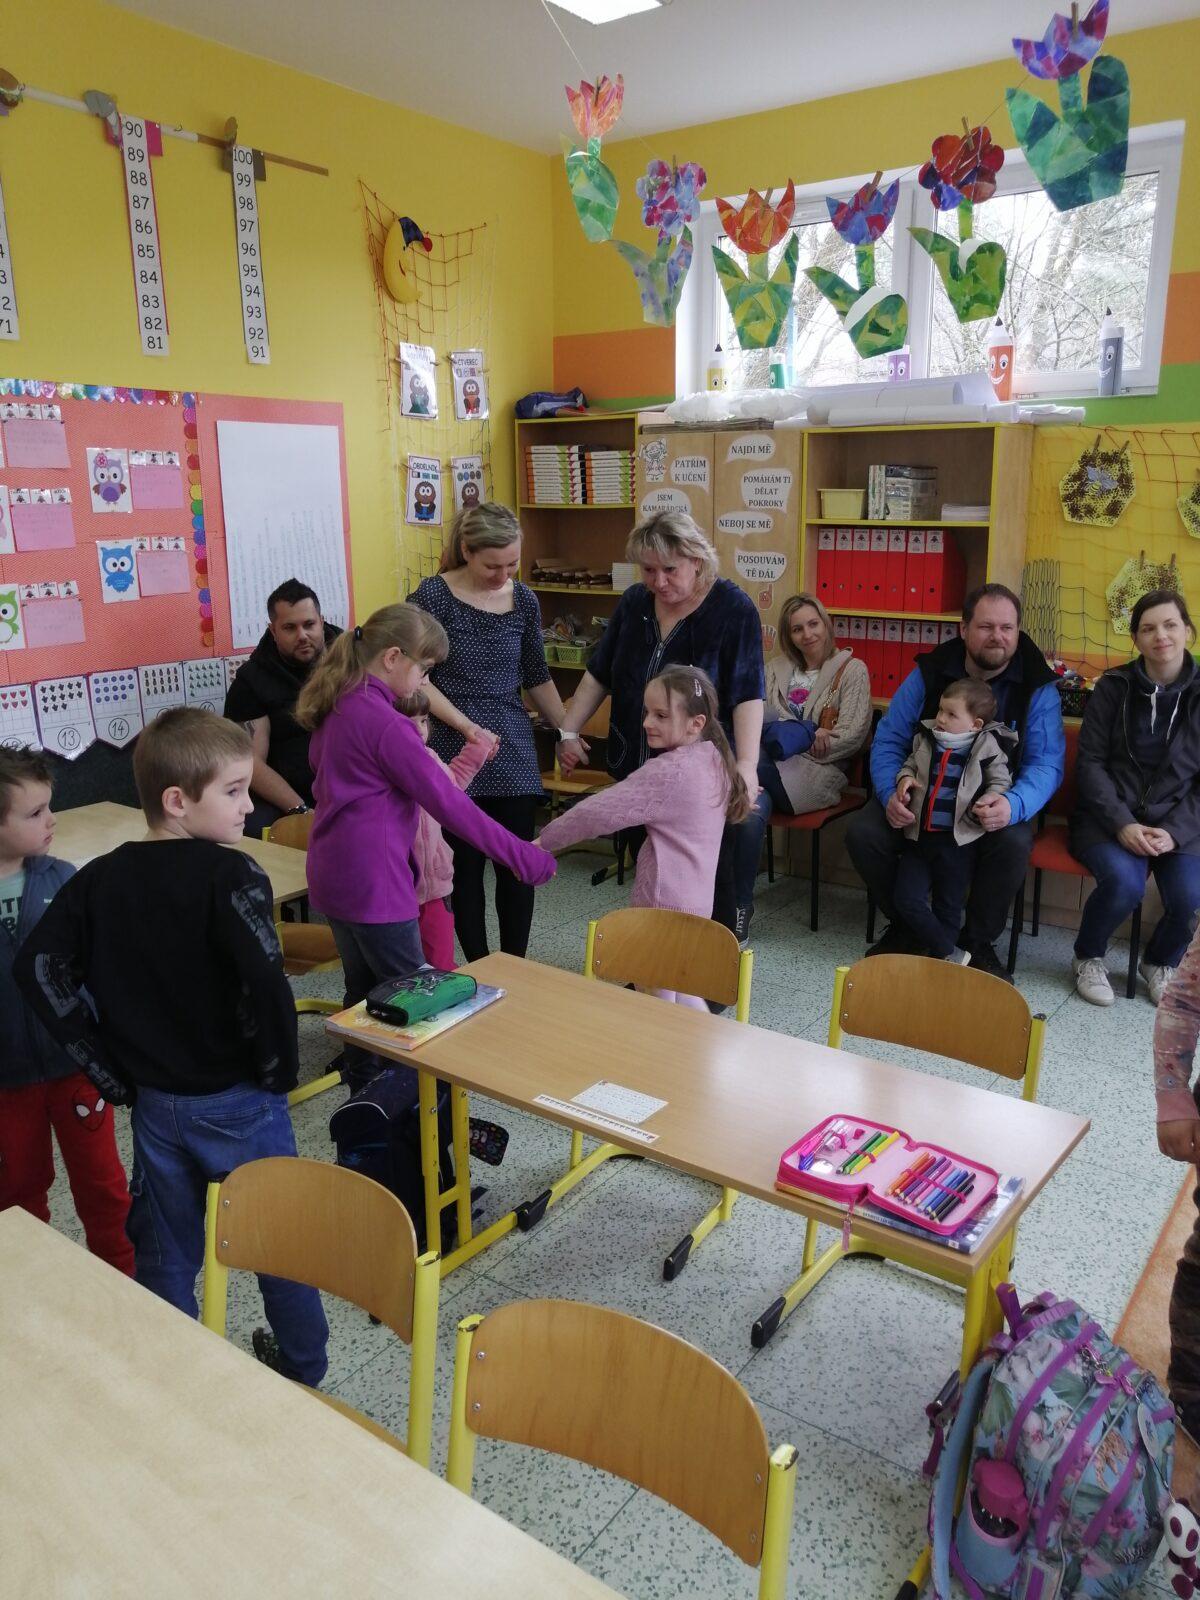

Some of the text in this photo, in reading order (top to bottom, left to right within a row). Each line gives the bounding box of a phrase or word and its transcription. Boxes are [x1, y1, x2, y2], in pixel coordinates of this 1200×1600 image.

[125, 121, 143, 138] 90
[127, 147, 145, 163] 89
[233, 148, 253, 165] 100
[130, 170, 148, 186] 88
[236, 172, 252, 187] 99
[132, 195, 150, 210] 87
[238, 196, 254, 211] 98
[135, 219, 153, 235] 86
[240, 218, 255, 232] 97
[137, 244, 155, 259] 85
[241, 243, 257, 256] 96
[140, 270, 158, 284] 84
[242, 263, 258, 278] 95
[245, 284, 261, 298] 94
[142, 294, 160, 308] 83
[246, 305, 262, 318] 93
[144, 316, 163, 330] 82
[248, 326, 264, 340] 92
[147, 336, 164, 349] 81
[251, 345, 266, 358] 91
[731, 444, 772, 455] NAJDI MĚ
[674, 473, 682, 481] K
[743, 474, 781, 484] POMÁHÁM
[657, 494, 673, 502] JSEM
[748, 499, 785, 507] POKROKY
[718, 518, 772, 529] NEBOJ SE MĚ
[737, 554, 785, 566] POSOUVÁM
[113, 722, 126, 737] 14
[62, 730, 76, 746] 13
